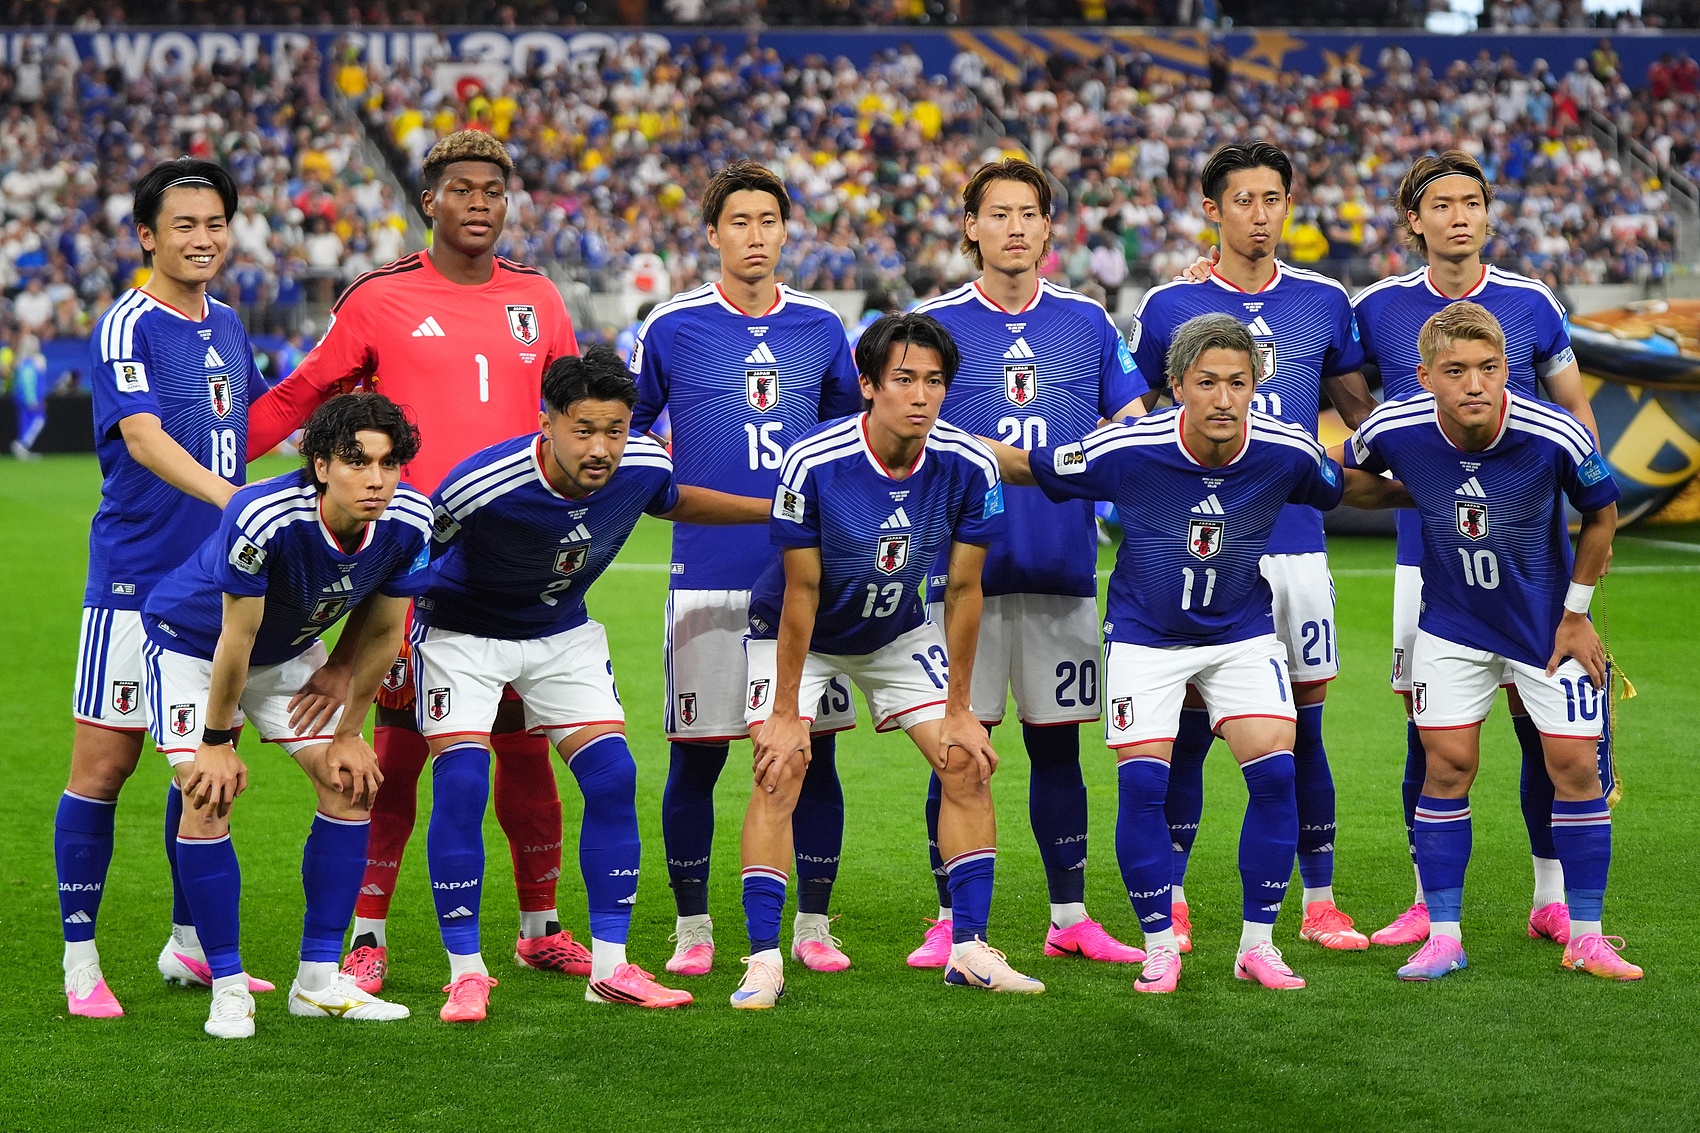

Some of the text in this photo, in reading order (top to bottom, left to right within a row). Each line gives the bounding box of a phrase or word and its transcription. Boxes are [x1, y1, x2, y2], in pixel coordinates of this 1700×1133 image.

[475, 354, 489, 402] 1
[744, 422, 783, 471] 15
[997, 416, 1047, 450] 20
[211, 429, 236, 478] 18
[1458, 547, 1500, 590] 10
[539, 579, 572, 606] 2
[861, 582, 904, 618] 13
[1181, 567, 1217, 611] 11
[291, 626, 321, 646] 7
[1301, 618, 1331, 666] 21
[912, 645, 949, 689] 13
[1269, 658, 1289, 702] 1
[1055, 659, 1097, 707] 20
[1559, 675, 1598, 722] 10
[524, 840, 563, 853] JAPA
[1055, 833, 1087, 845] JAP
[367, 859, 398, 868] PAN
[609, 868, 640, 876] JAP
[668, 856, 709, 868] JAPAN
[798, 853, 840, 864] JAPAN
[59, 882, 101, 892] JAPAN
[433, 878, 478, 890] JAPAN
[1129, 883, 1171, 898] JAPAN
[1261, 881, 1288, 889] JAP
